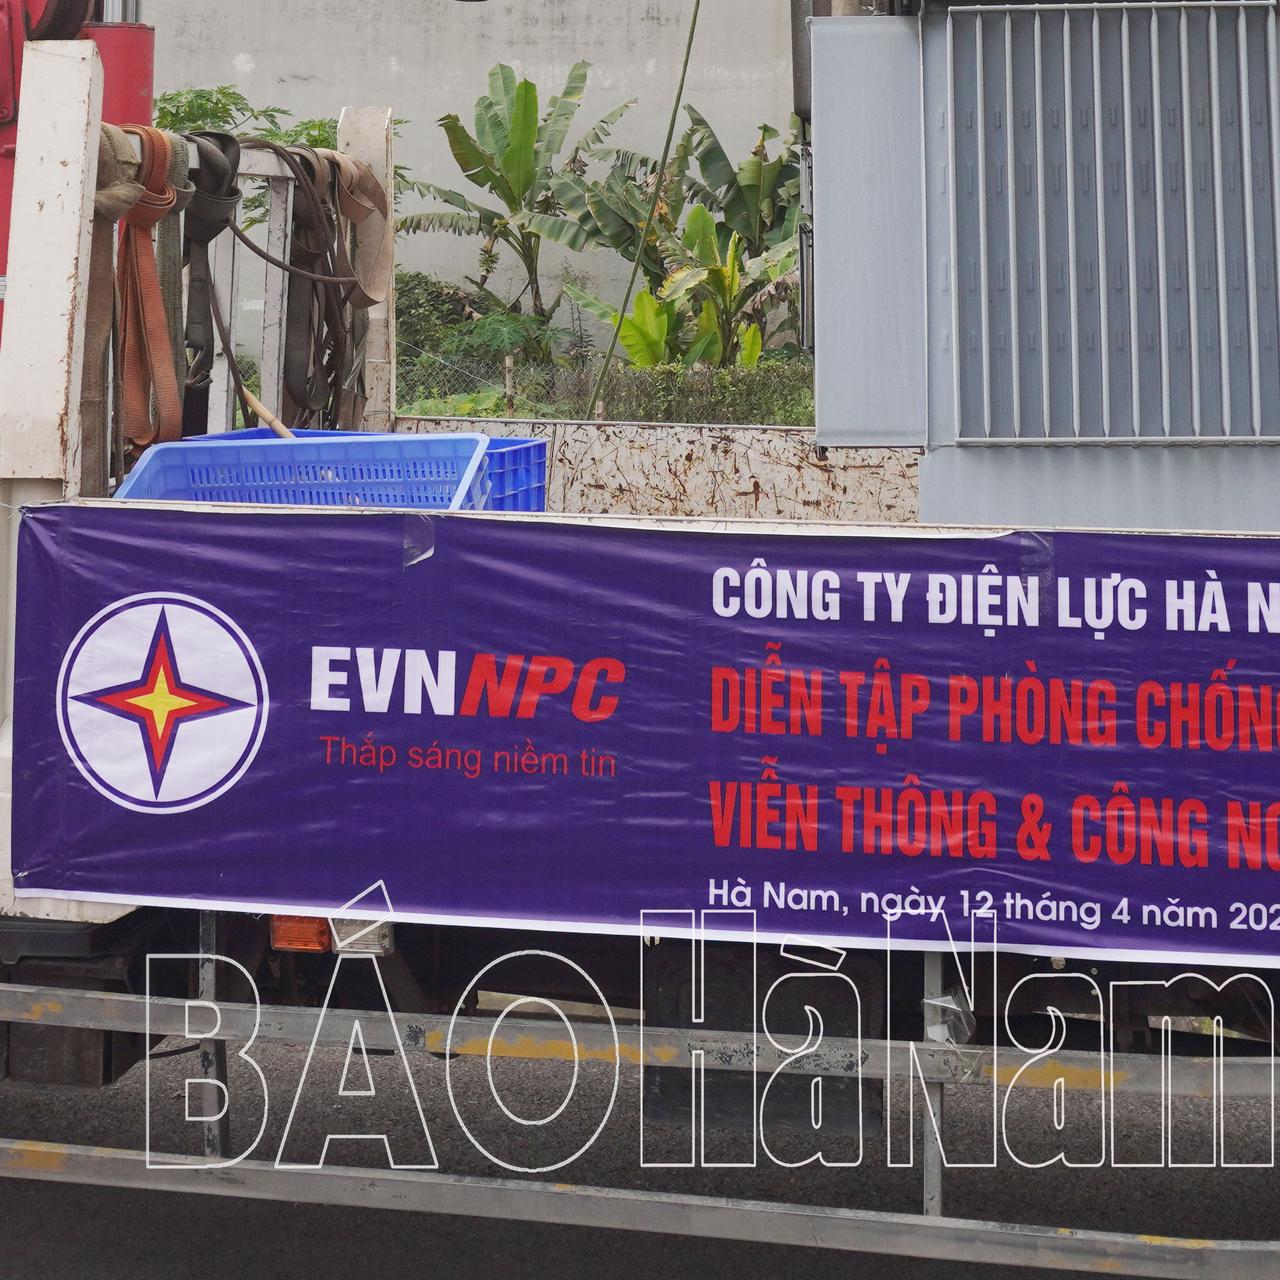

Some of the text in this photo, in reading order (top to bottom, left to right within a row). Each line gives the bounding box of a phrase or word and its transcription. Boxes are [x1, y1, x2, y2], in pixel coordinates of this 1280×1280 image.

[712, 558, 841, 621] CÔNG
[857, 572, 911, 623] TY
[926, 563, 1040, 637] ĐIỆN
[1058, 572, 1148, 640] LỰC
[1165, 570, 1231, 632] HÀ
[711, 641, 822, 737] DIỄN
[840, 657, 931, 754] TẬP
[948, 660, 1117, 747] PHÒNG
[319, 730, 616, 779] Thắp sáng niềm tin
[709, 755, 819, 852] VIỄN
[835, 773, 997, 859] THÔNG
[1016, 792, 1052, 862] &
[1071, 781, 1208, 868] CÔNG
[708, 877, 752, 908] Hà
[763, 881, 850, 917] Nam,
[860, 886, 945, 923] ngày
[960, 890, 995, 919] 12
[1003, 891, 1102, 930] tháng
[1111, 898, 1132, 924] 4
[1142, 898, 1217, 929] năm
